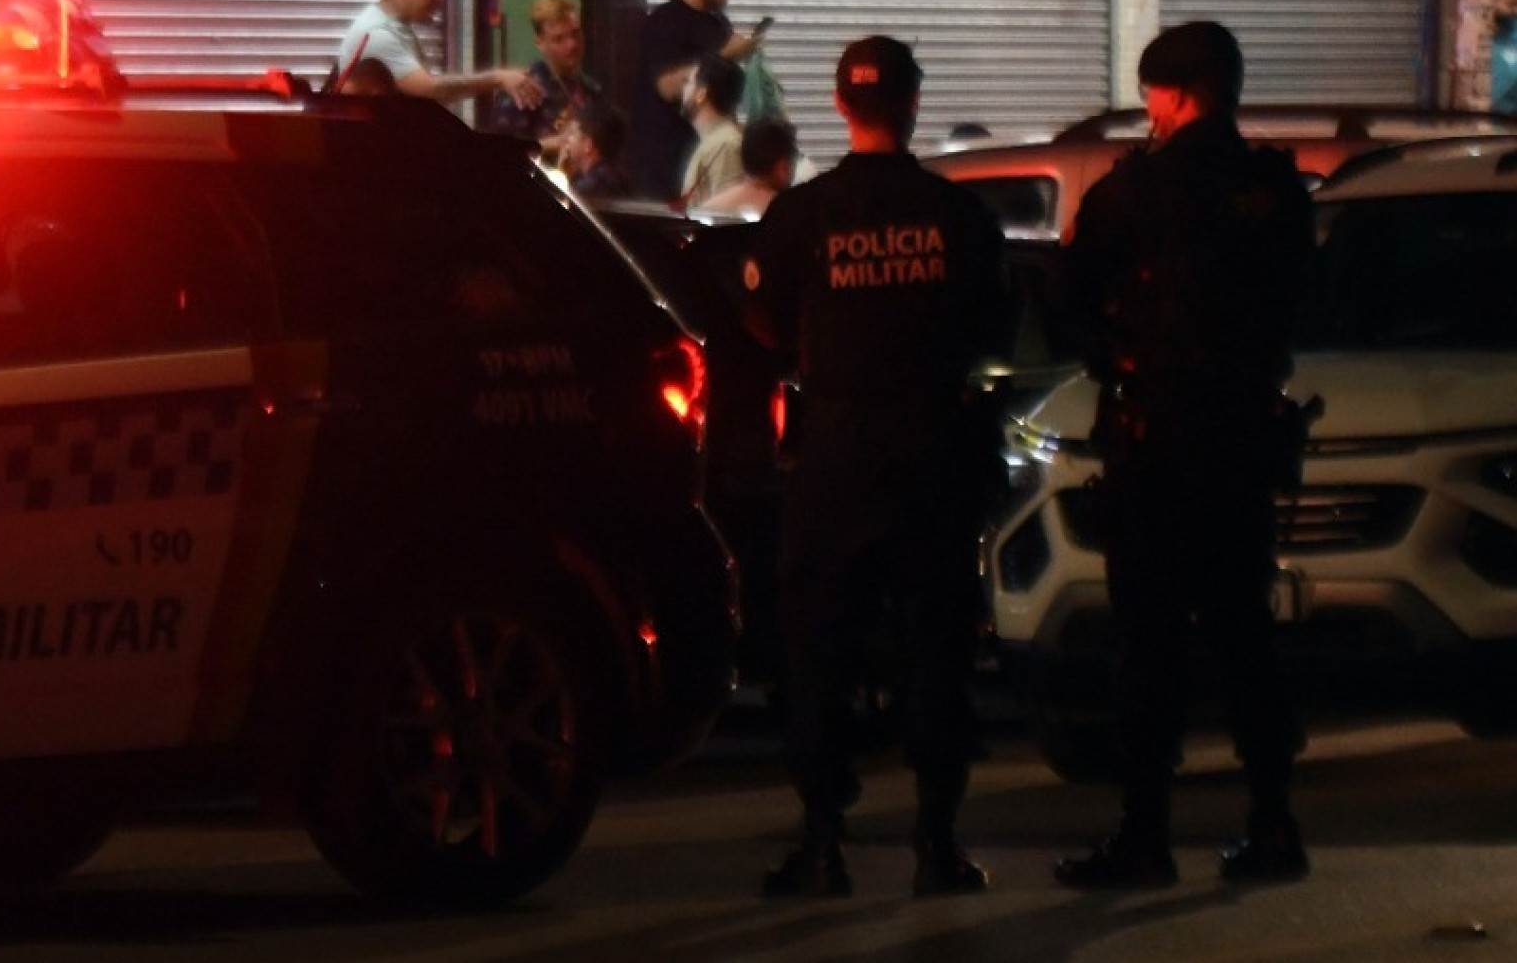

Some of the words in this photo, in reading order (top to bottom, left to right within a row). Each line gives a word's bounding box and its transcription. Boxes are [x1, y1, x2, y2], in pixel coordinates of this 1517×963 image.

[828, 222, 944, 260] POLÍCIA
[830, 258, 946, 289] MILITAR
[129, 529, 193, 566] 190
